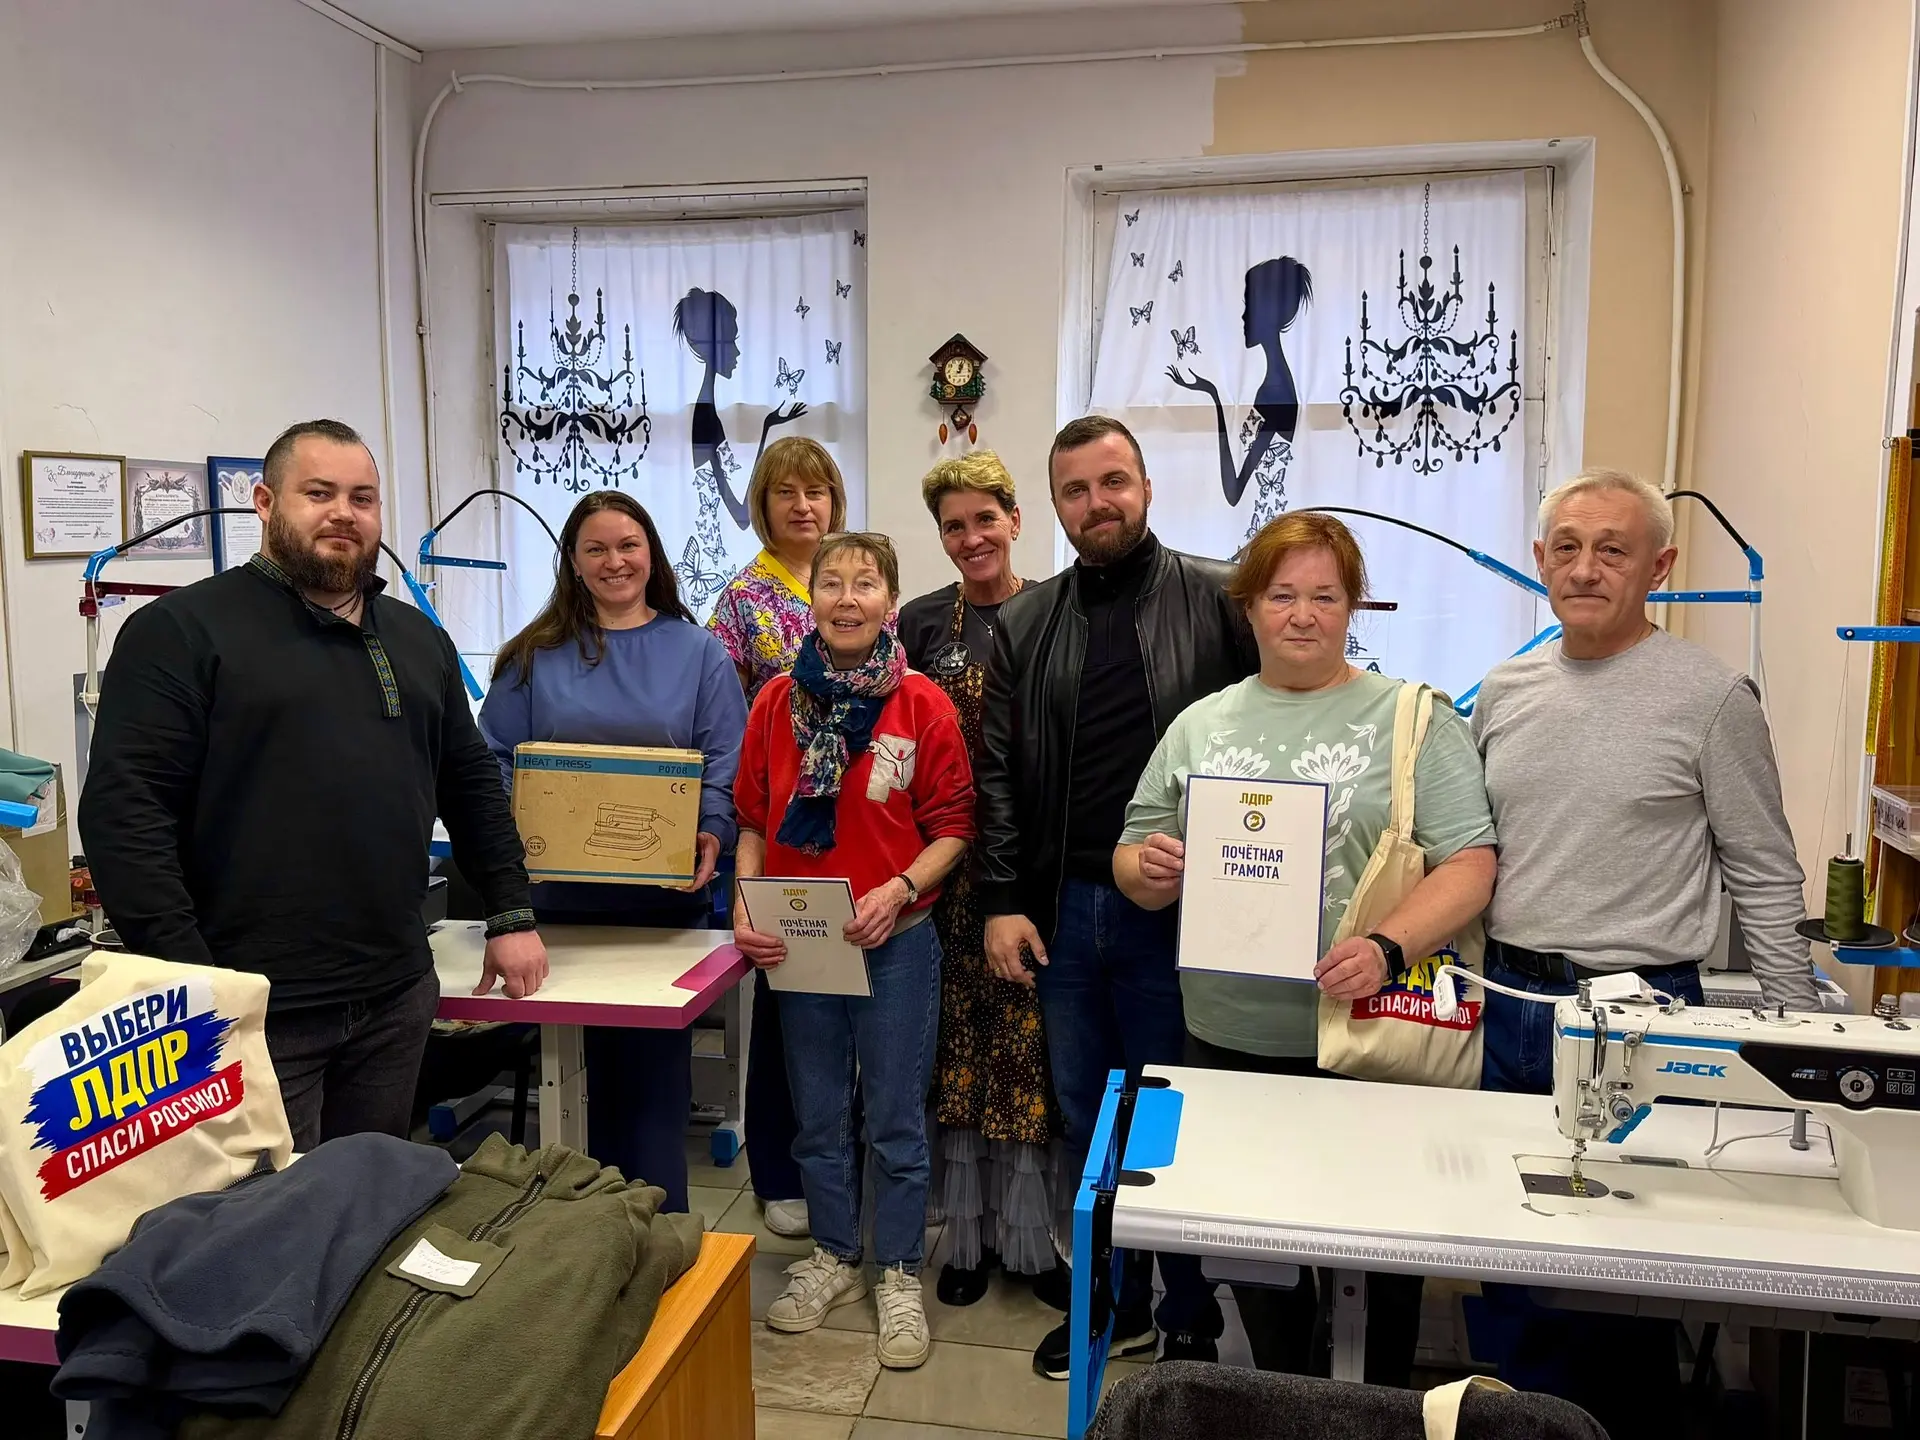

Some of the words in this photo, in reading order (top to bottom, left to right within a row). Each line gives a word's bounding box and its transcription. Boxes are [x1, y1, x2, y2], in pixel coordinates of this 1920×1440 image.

[523, 757, 551, 767] HEAT
[555, 759, 592, 769] PRESS
[658, 765, 688, 775] P0708
[670, 782, 687, 794] CE
[1239, 792, 1273, 806] ЛДПР
[1221, 844, 1283, 863] ПОЧЁТНАЯ
[1223, 862, 1280, 880] ГРАМОТА
[782, 888, 808, 897] ЛДПР
[779, 918, 828, 928] ПОЧЁТНАЯ
[784, 929, 828, 938] ГРАМОТА
[1368, 994, 1420, 1017] СПАСИ
[60, 985, 188, 1069] ВЫБЕРИ
[69, 1029, 189, 1131] ЛДПР
[65, 1122, 145, 1179] СПАСИ
[149, 1077, 232, 1137] РОССИЮ!
